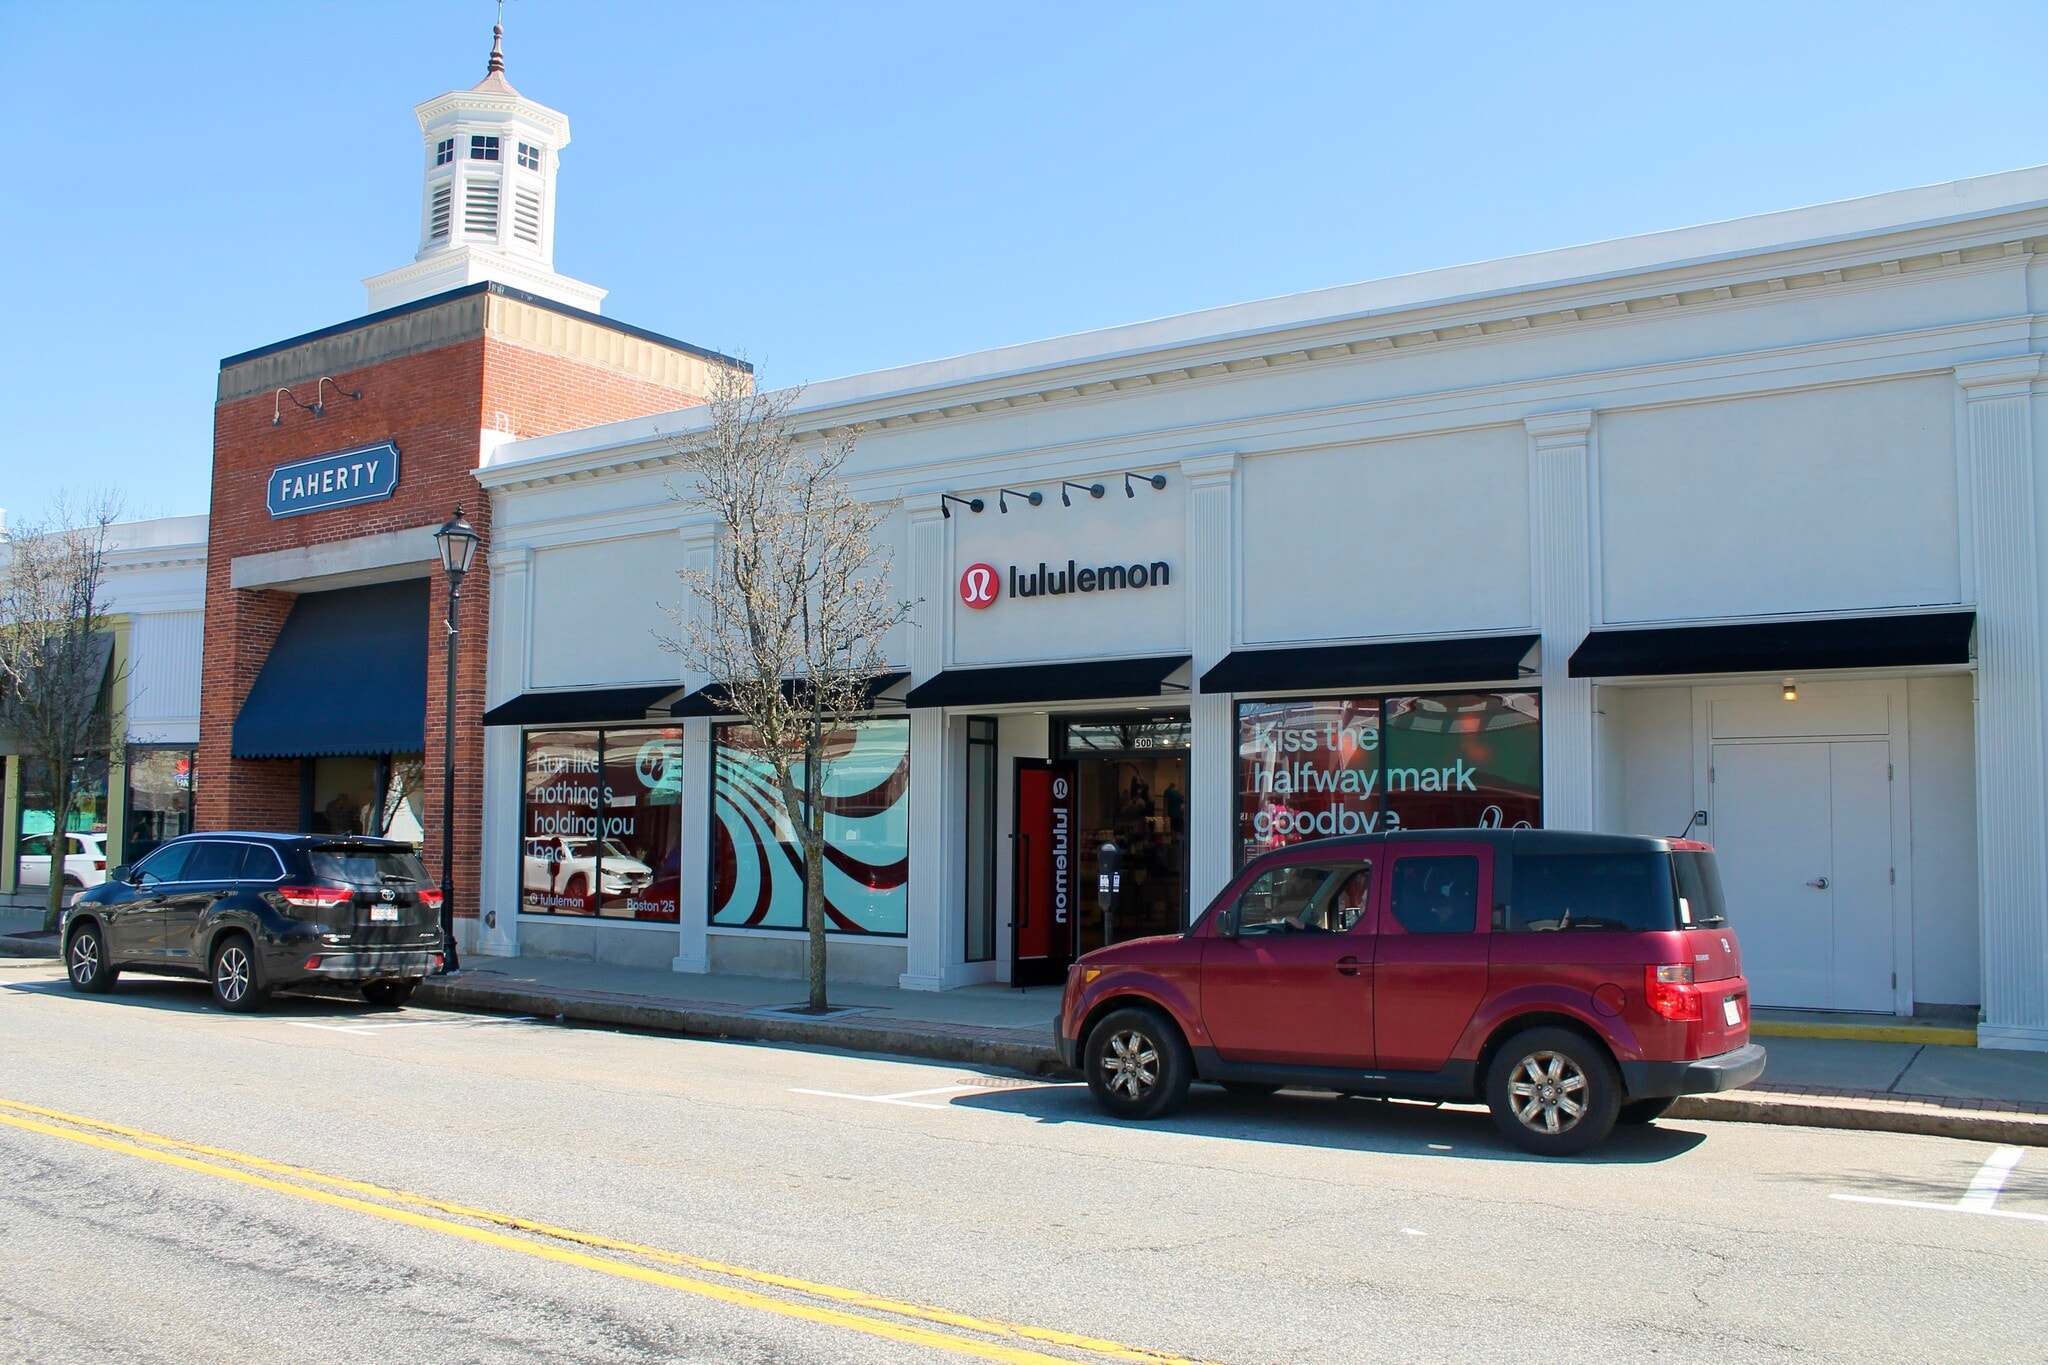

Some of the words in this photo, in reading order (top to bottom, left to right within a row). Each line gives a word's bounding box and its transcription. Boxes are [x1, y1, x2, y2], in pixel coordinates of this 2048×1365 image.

[282, 460, 379, 501] FAHERTY
[1009, 560, 1170, 598] lululemon
[1255, 721, 1317, 752] Kiss
[1326, 720, 1379, 752] the
[536, 751, 569, 774] Run
[573, 750, 599, 774] like
[1254, 761, 1378, 800] halfway
[1387, 759, 1477, 792] mark
[535, 780, 613, 809] nothings
[534, 811, 597, 838] holding
[602, 816, 634, 838] you
[540, 893, 584, 908] lululemon
[626, 897, 659, 912] Boston
